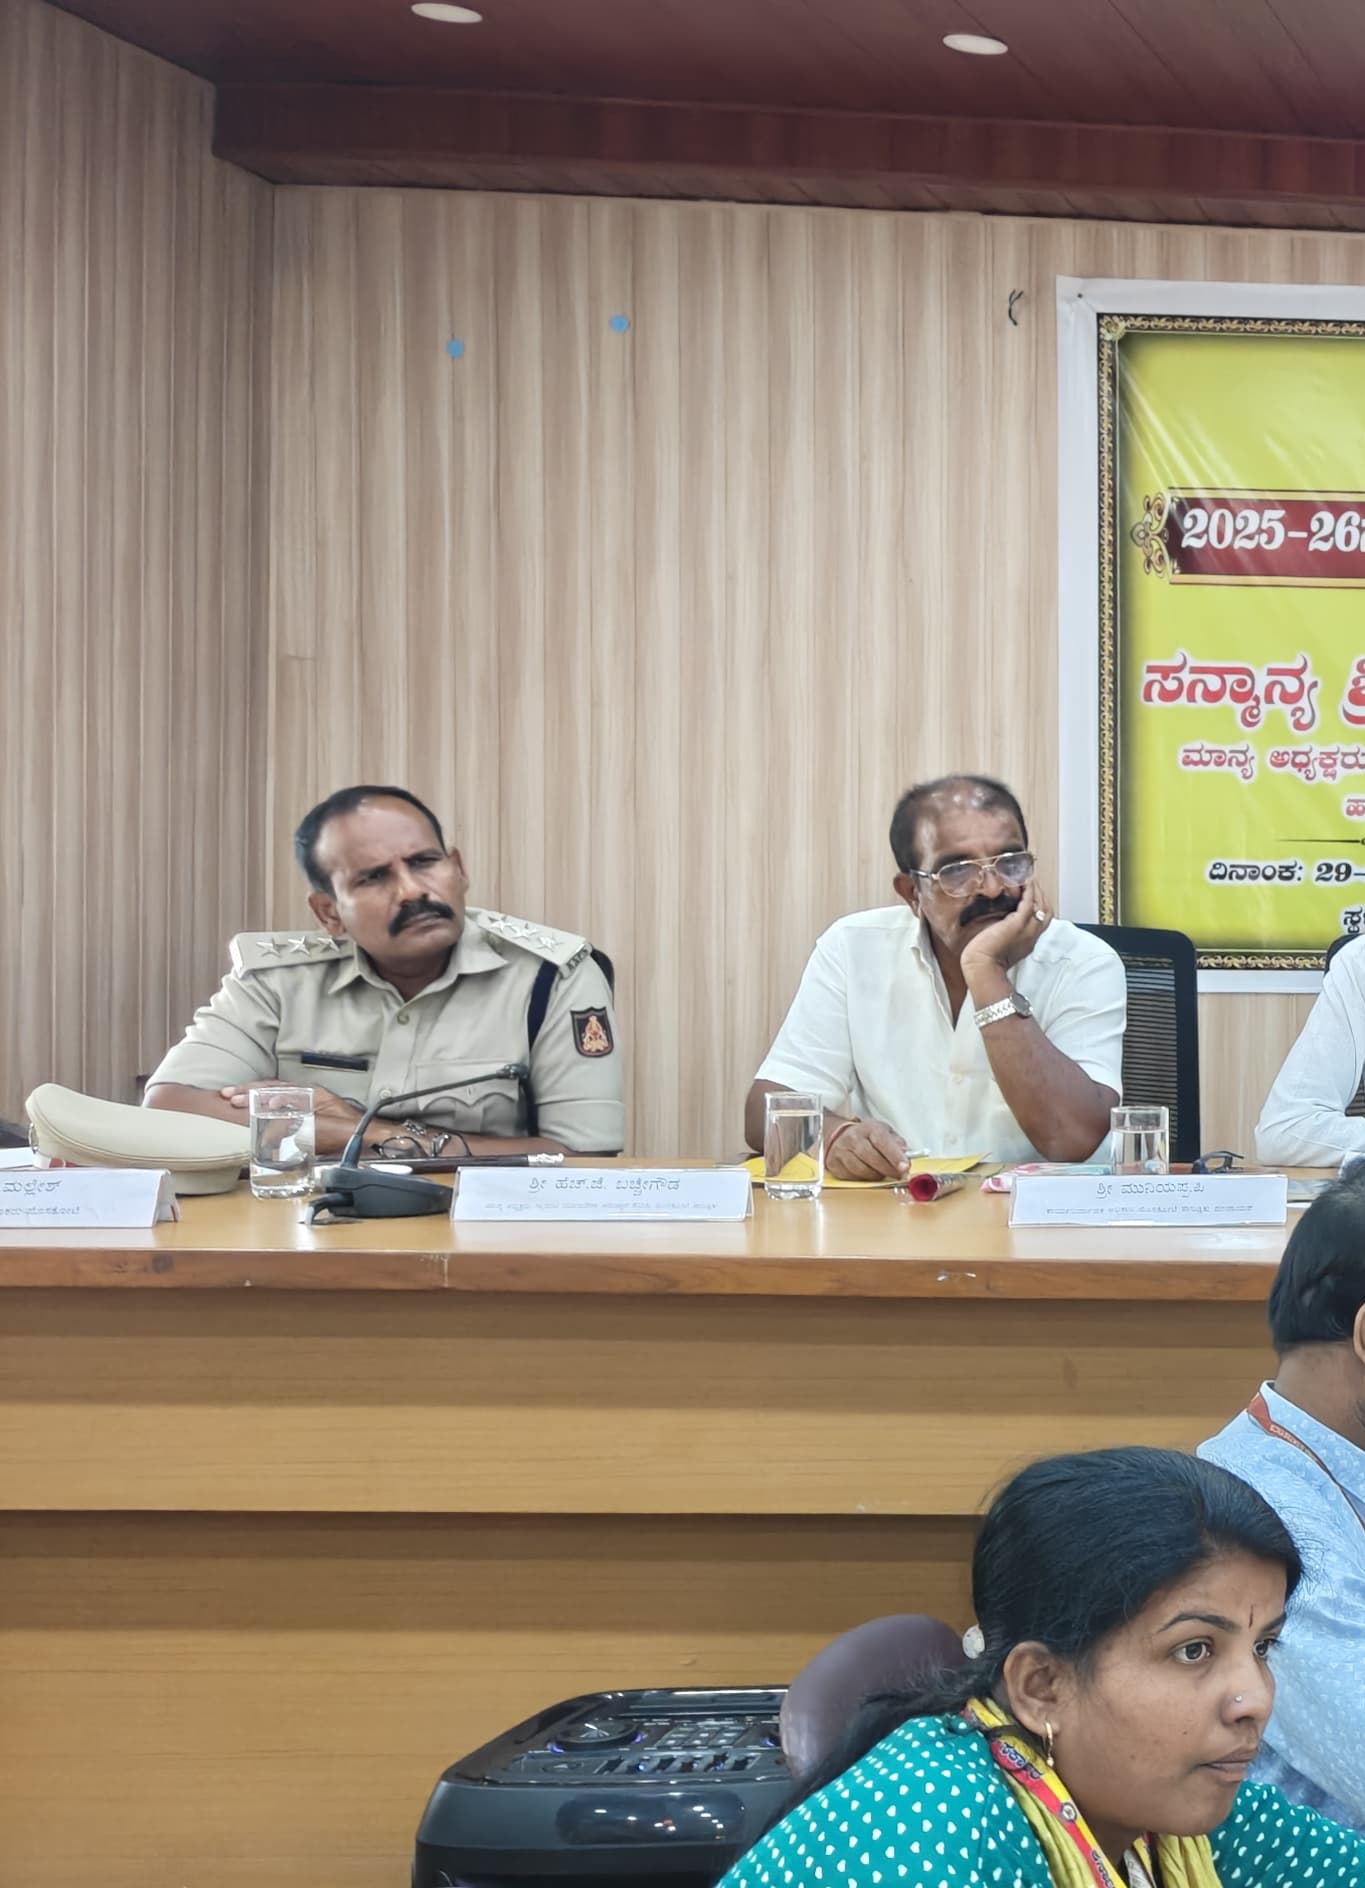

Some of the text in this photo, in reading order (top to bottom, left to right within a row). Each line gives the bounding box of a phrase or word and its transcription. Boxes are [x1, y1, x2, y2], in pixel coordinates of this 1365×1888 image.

[1142, 652, 1318, 732] ಸನ್ಮಾನ್ಯ
[1182, 744, 1255, 780] ಮಾನ್ಯ
[1208, 860, 1303, 883] ದಿನಾಂಕ:
